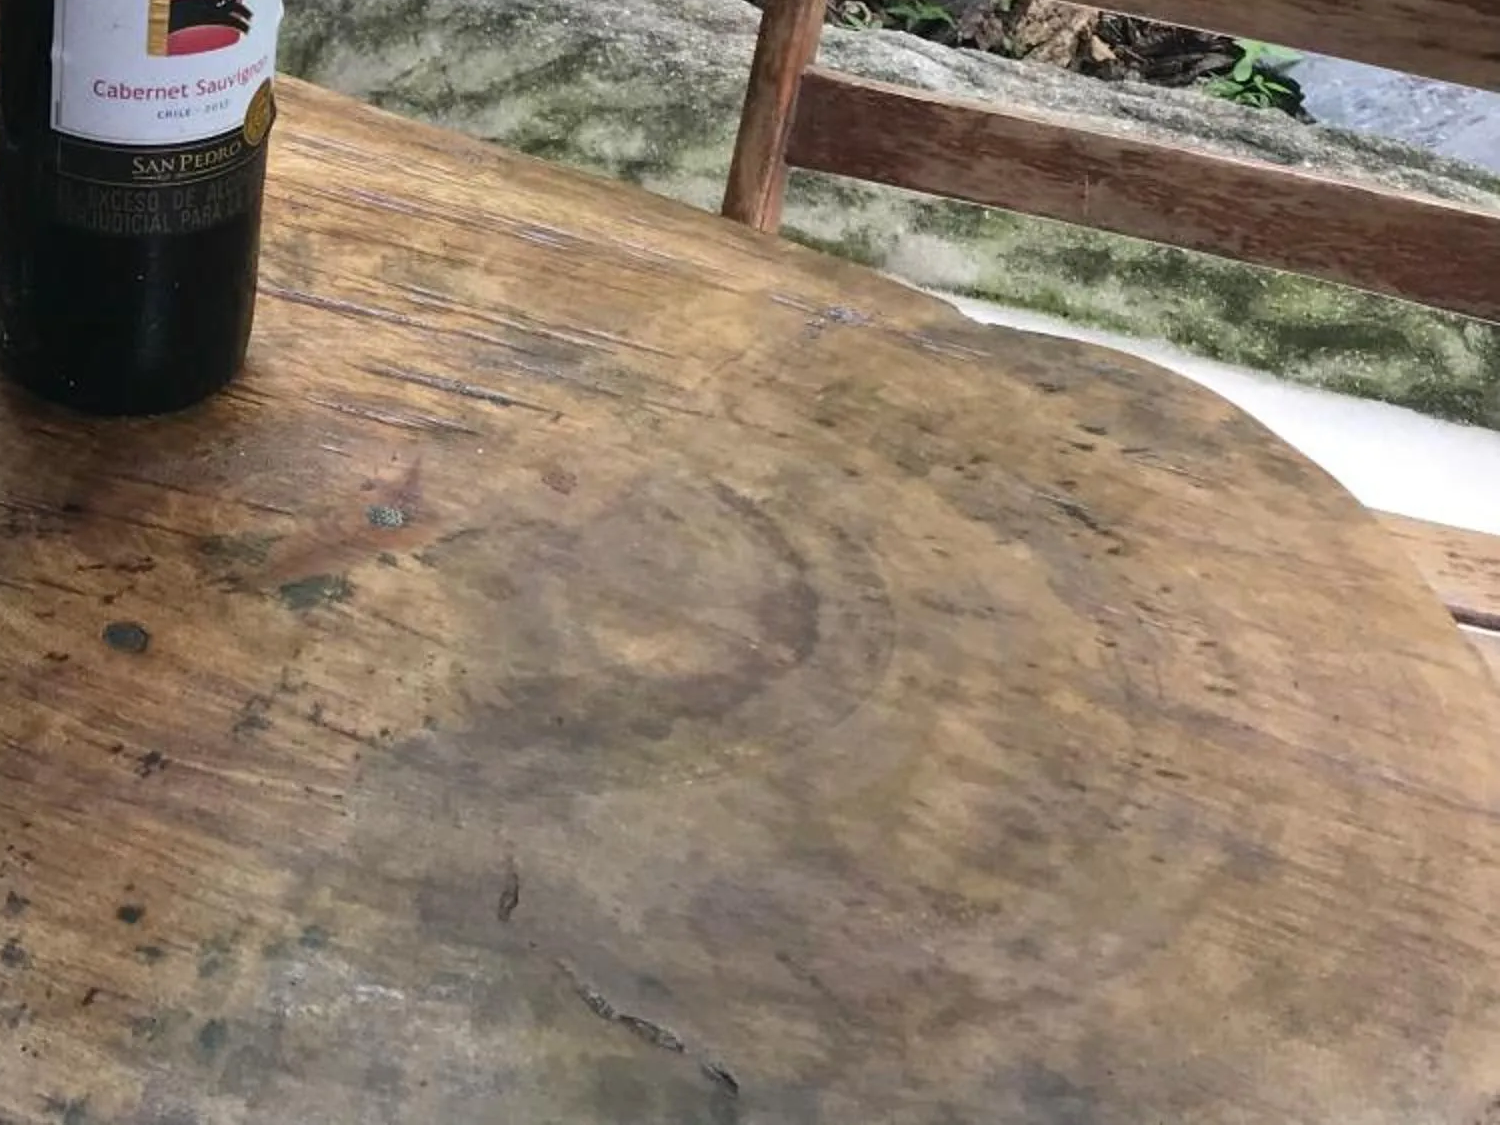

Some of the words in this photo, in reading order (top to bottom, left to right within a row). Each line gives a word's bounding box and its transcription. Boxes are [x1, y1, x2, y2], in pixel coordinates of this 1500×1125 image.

[93, 76, 189, 101] Cabernet
[156, 109, 191, 121] CHILE
[131, 155, 175, 175] SAN
[180, 140, 242, 172] PEDRO
[88, 186, 160, 212] EXCESO
[172, 188, 197, 210] DE
[60, 205, 174, 235] RJUDICIAL
[180, 201, 221, 231] PARA
